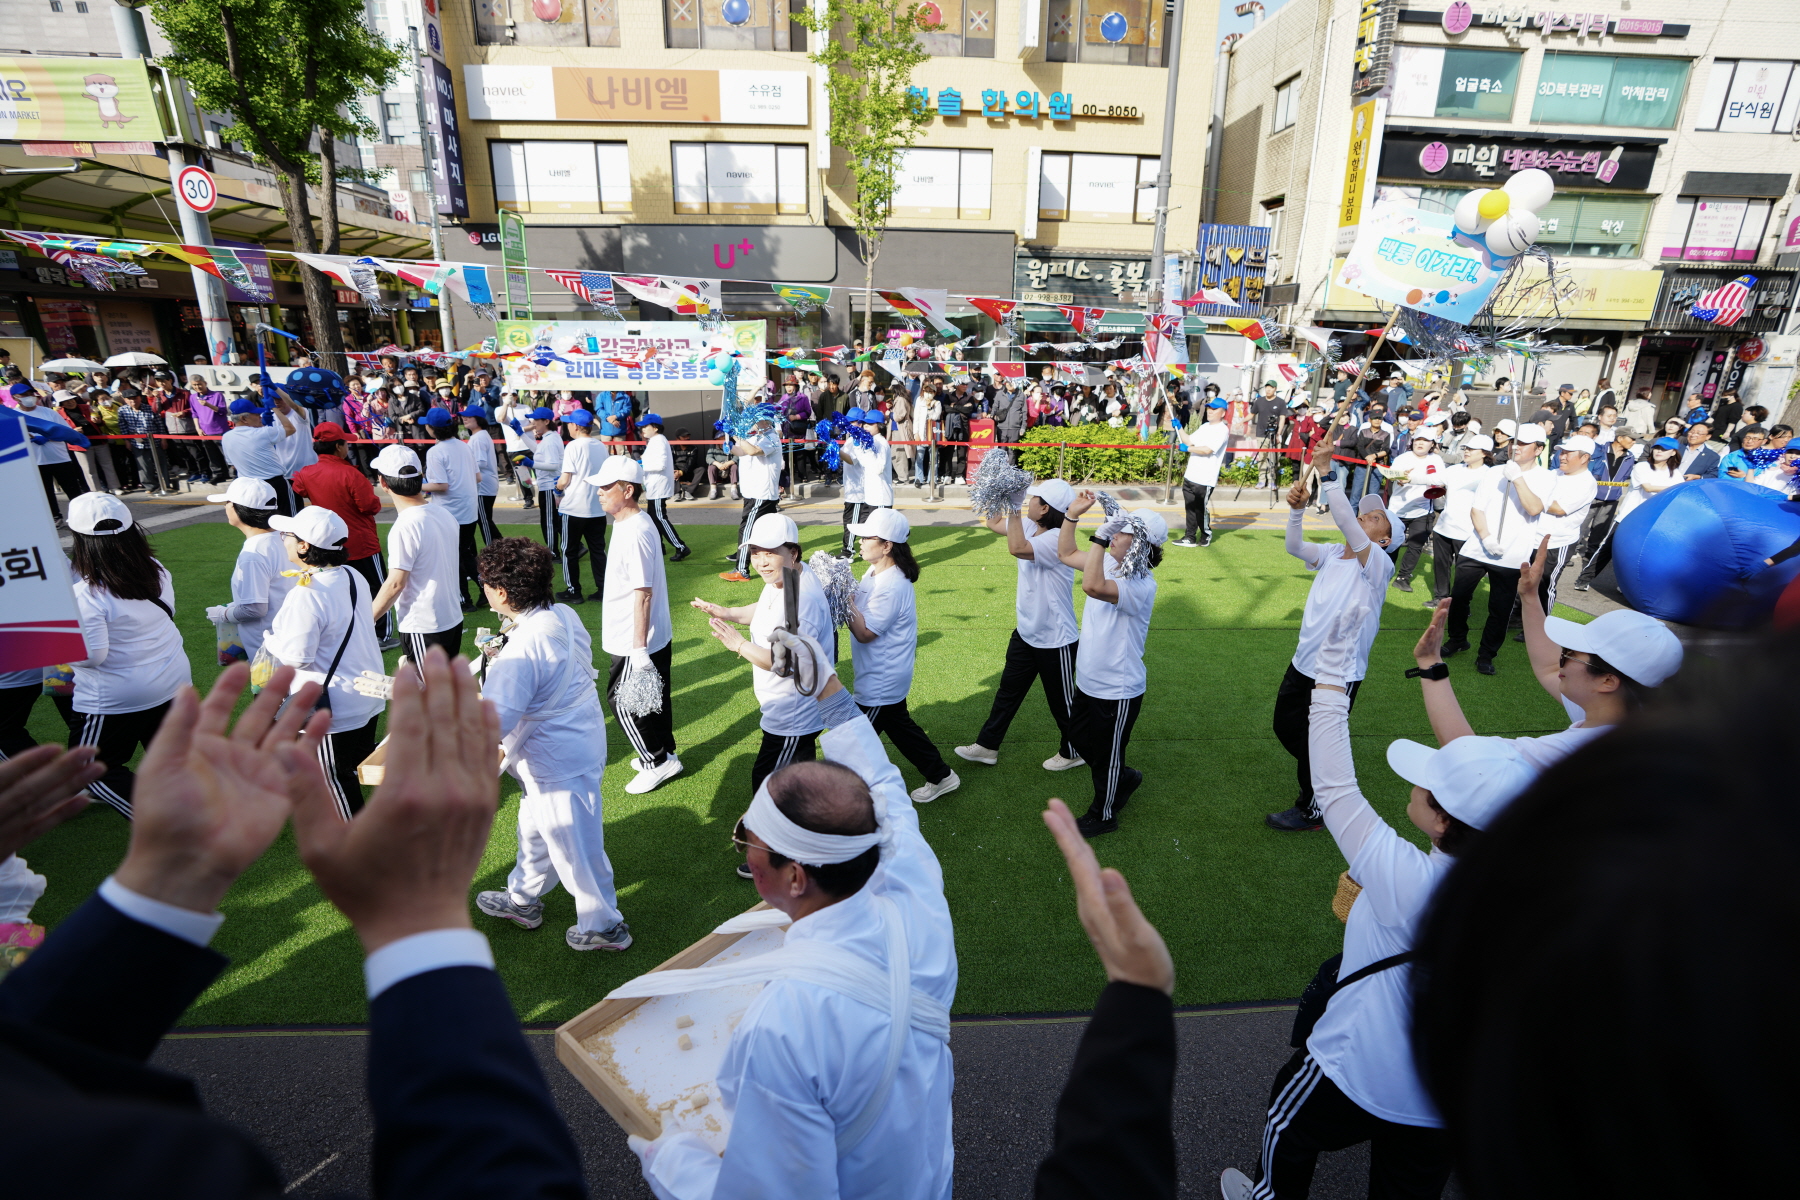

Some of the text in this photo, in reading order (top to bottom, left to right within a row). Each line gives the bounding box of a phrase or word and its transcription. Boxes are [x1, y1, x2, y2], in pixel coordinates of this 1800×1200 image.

[1481, 3, 1661, 39] 미원 에스테틱 6015-9015
[586, 76, 688, 111] 나비엘
[748, 84, 782, 98] 수유점
[1455, 77, 1502, 94] 얼굴축소
[1538, 81, 1604, 99] 3D복부관리
[1621, 85, 1670, 102] 하체관리
[981, 88, 1072, 120] 한의원
[1082, 104, 1138, 117] 00-8050
[9, 111, 41, 120] MARKET
[443, 107, 461, 184] 마사지
[1452, 143, 1499, 177] 미원
[549, 169, 571, 177] 나비엘
[912, 175, 934, 183] 나비엘
[185, 179, 209, 200] 30
[1600, 219, 1624, 235] 왁싱
[713, 238, 755, 269] U+
[338, 291, 358, 303] BYC
[565, 360, 619, 379] 한마음
[970, 428, 992, 439] 119
[0, 546, 47, 587] 회
